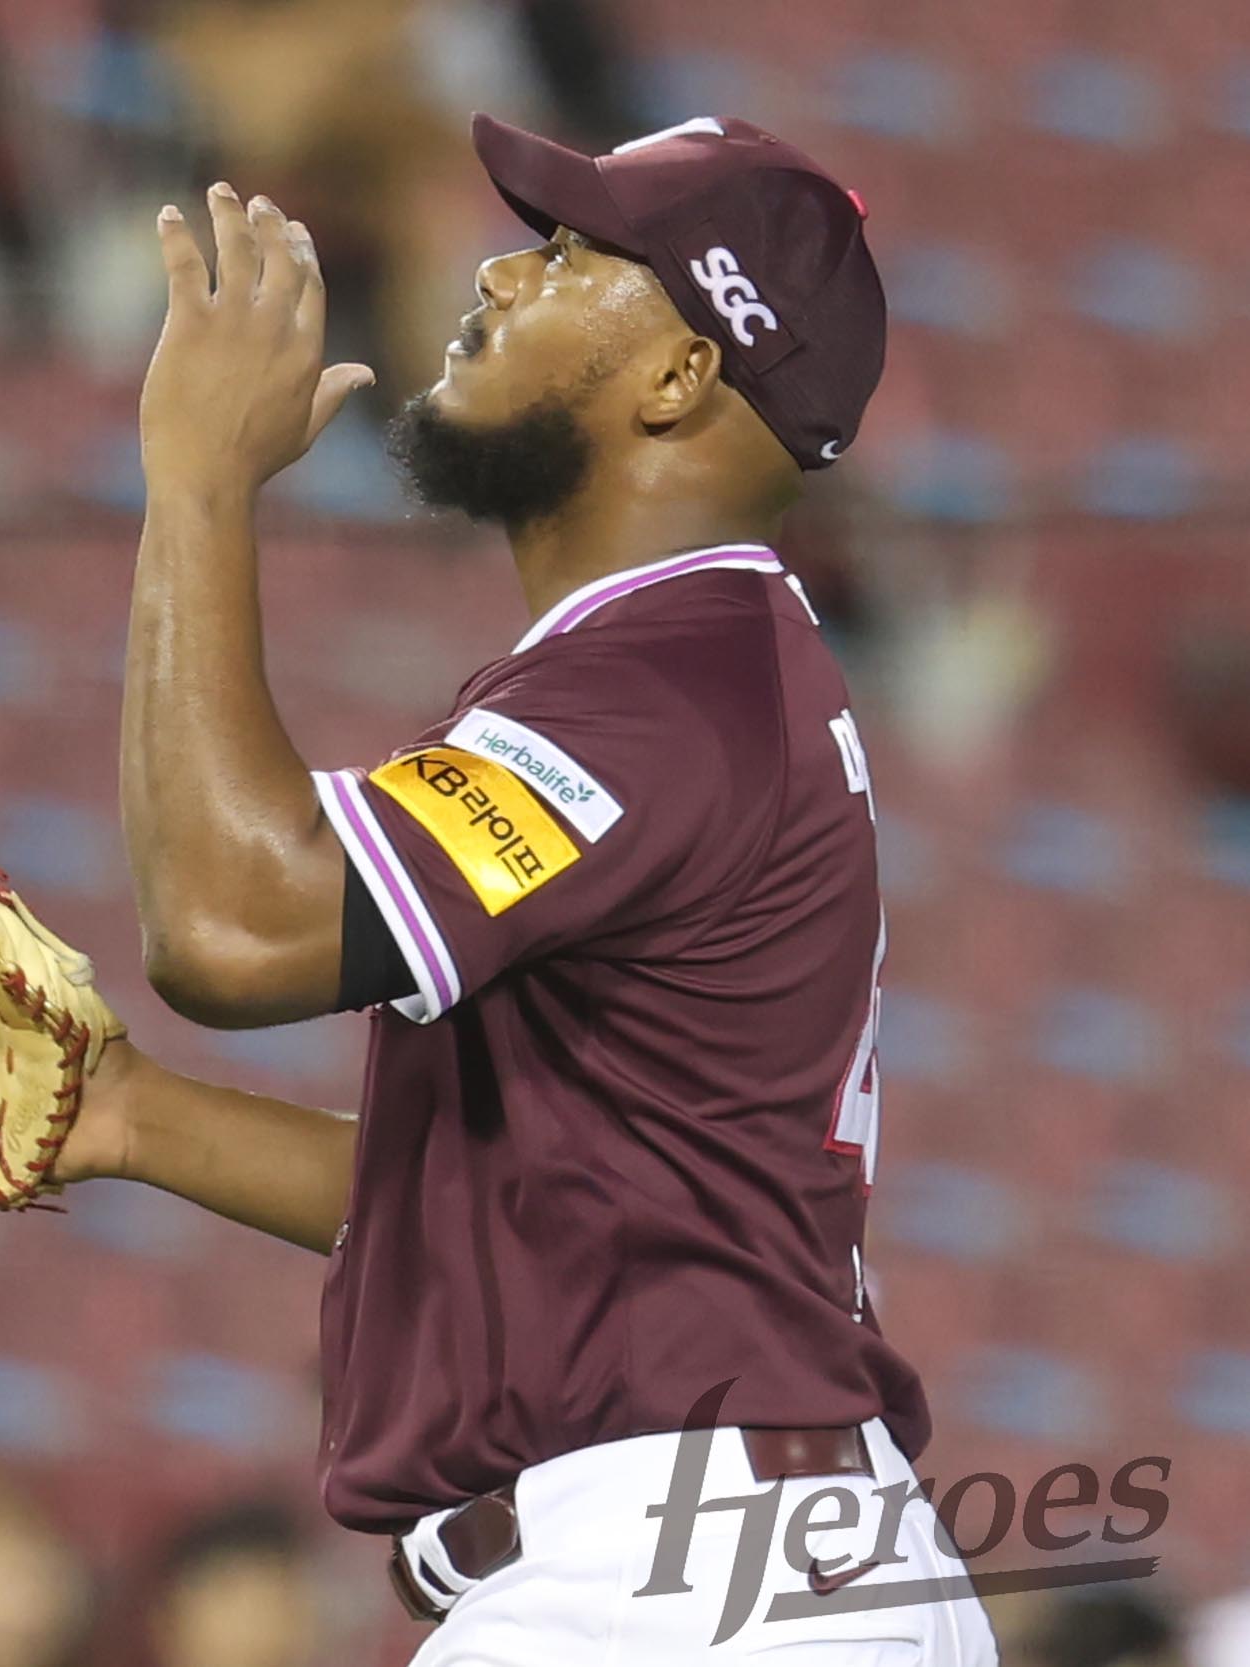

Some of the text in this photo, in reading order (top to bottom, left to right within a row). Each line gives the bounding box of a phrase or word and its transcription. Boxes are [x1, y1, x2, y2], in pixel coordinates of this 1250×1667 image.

[690, 247, 778, 347] SGC
[475, 727, 577, 804] Herbalife
[401, 753, 545, 889] KB라이프
